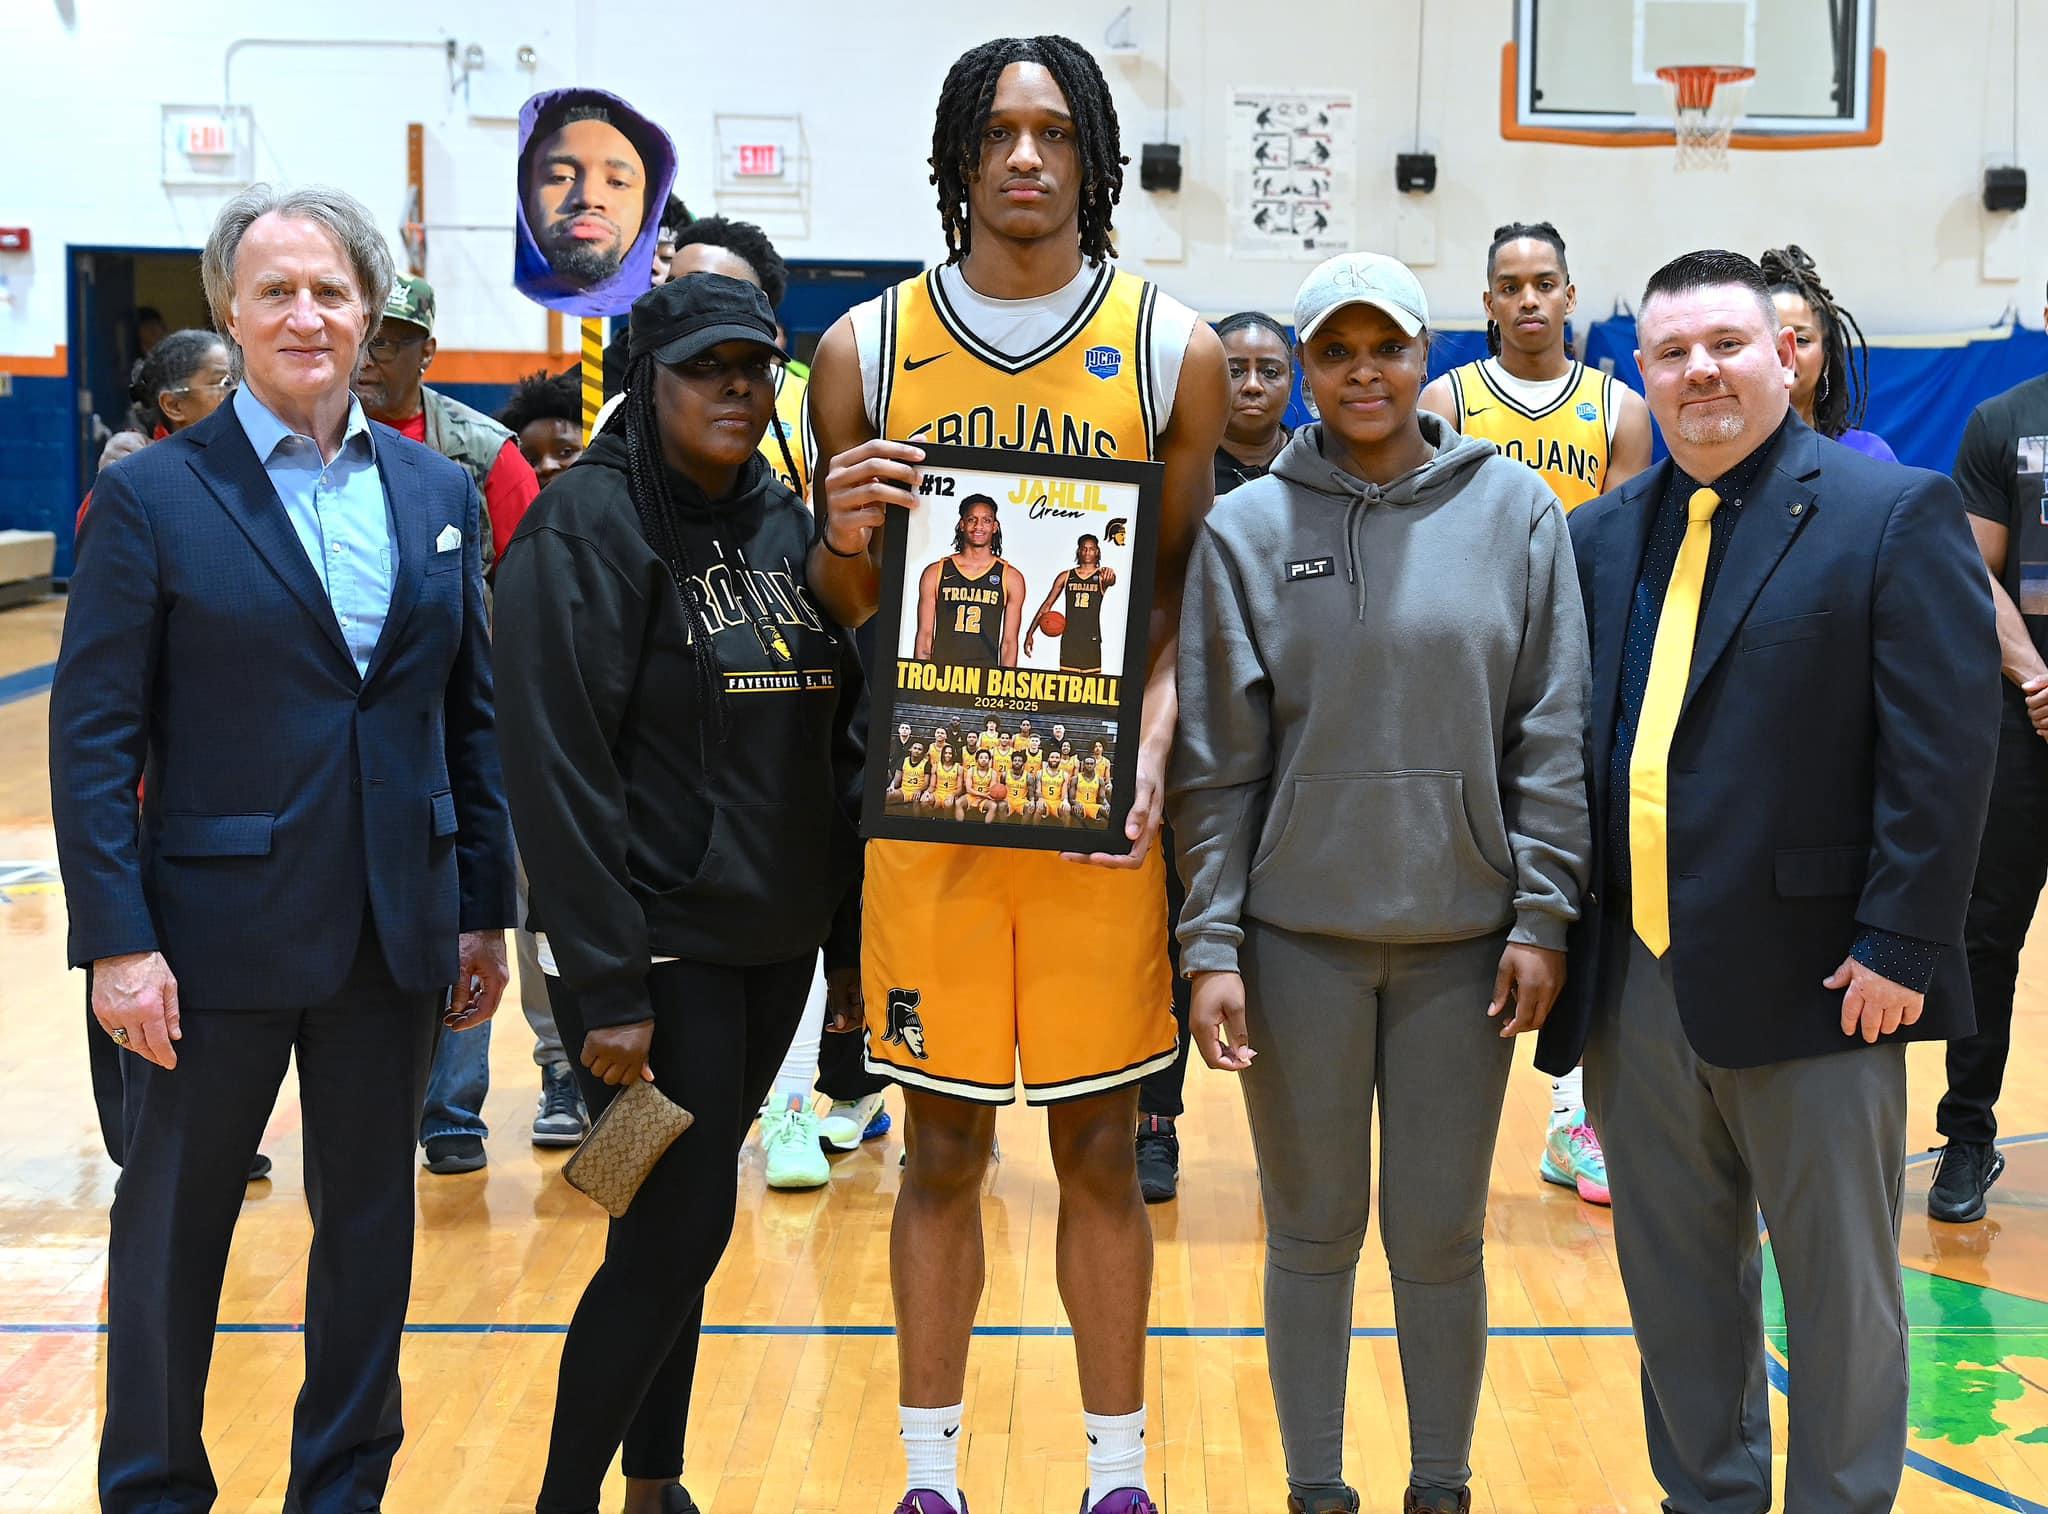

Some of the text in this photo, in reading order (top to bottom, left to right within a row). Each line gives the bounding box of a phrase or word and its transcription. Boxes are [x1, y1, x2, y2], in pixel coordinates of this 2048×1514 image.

[739, 145, 776, 175] EXIT
[1085, 350, 1121, 368] NJCAA
[919, 474, 955, 497] #12
[1008, 479, 1108, 512] JAHLIL
[1029, 495, 1085, 520] Green
[1291, 560, 1328, 577] PLT
[942, 587, 999, 605] TROJANS
[1074, 592, 1090, 608] 12
[953, 604, 982, 634] 12
[896, 661, 1121, 706] TROJAN BASKETBALL
[974, 696, 1039, 712] 2024-2025
